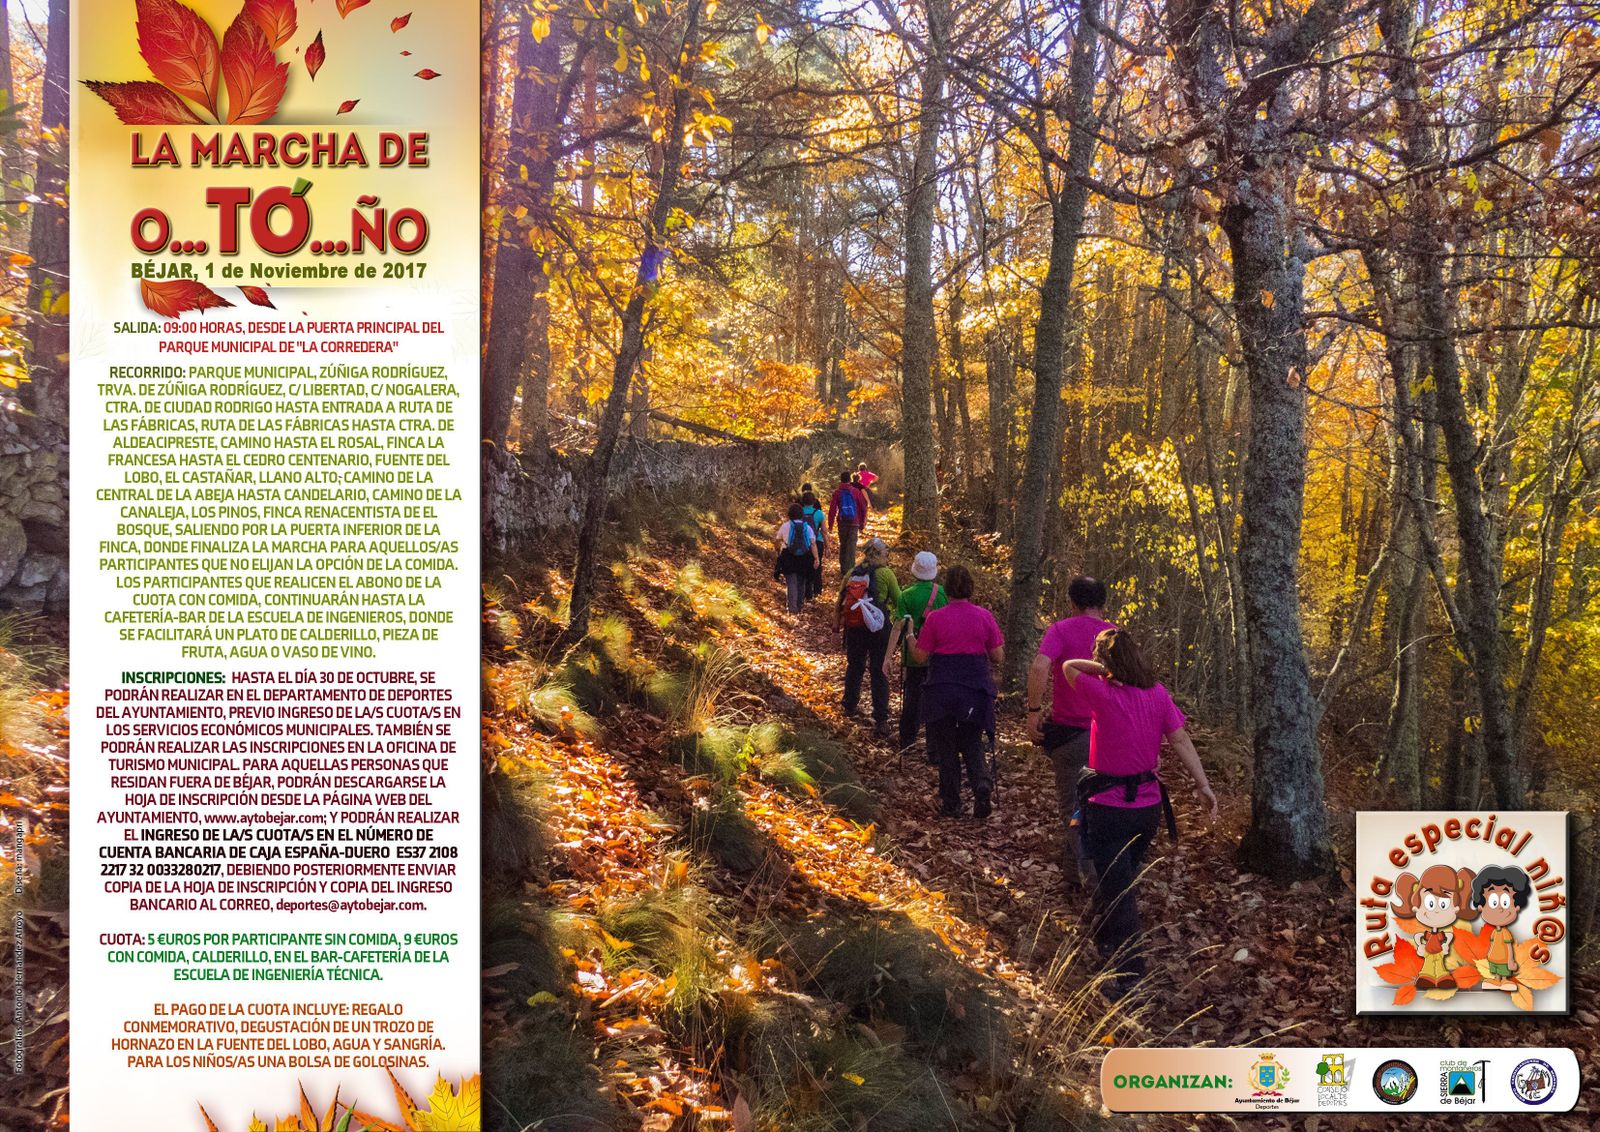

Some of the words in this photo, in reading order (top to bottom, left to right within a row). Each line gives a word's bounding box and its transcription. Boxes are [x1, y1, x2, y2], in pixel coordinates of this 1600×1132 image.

[131, 131, 179, 167] LA
[190, 131, 368, 167] MARCHA
[379, 131, 429, 167] DE
[131, 259, 199, 281] BÉJAR,
[205, 263, 214, 278] 1
[221, 262, 244, 279] de
[250, 262, 348, 279] Noviembre
[354, 262, 377, 279] de
[382, 262, 427, 279] 2017
[114, 322, 161, 334] SALIDA:
[164, 322, 196, 334] 09:00
[200, 322, 245, 336] HORAS,
[248, 322, 286, 334] DESDE
[289, 322, 304, 334] LA
[308, 322, 354, 334] PUERTA
[357, 322, 419, 334] PRINCIPAL
[423, 322, 444, 334] DEL
[160, 341, 208, 355] PARQUE
[212, 341, 276, 353] MUNICIPAL
[280, 341, 294, 353] DE
[297, 341, 318, 353] "LA
[321, 341, 398, 353] CORREDERA"
[110, 366, 185, 379] RECORRIDO:
[189, 366, 241, 381] PARQUE
[245, 366, 316, 381] MUNICIPAL,
[319, 363, 368, 379] ZÚÑIGA
[372, 363, 447, 381] RODRÍGUEZ,
[104, 419, 128, 431] LAS
[131, 416, 198, 434] FÁBRICAS,
[201, 419, 236, 431] RUTA
[239, 419, 254, 431] DE
[258, 419, 282, 431] LAS
[286, 416, 349, 431] FÁBRICAS
[352, 419, 395, 431] HASTA
[399, 419, 435, 431] CTRA.
[438, 419, 454, 431] DE
[109, 454, 176, 466] FRANCESA
[180, 454, 223, 466] HASTA
[226, 454, 241, 466] EL
[244, 454, 285, 466] CEDRO
[289, 454, 372, 469] CENTENARIO,
[376, 454, 423, 466] FUENTE
[427, 454, 450, 466] DEL
[121, 506, 188, 521] CANALEJA,
[192, 506, 216, 518] LOS
[219, 506, 260, 521] PINOS,
[264, 506, 302, 518] FINCA
[305, 506, 400, 518] RENACENTISTA
[404, 506, 420, 518] DE
[424, 506, 437, 518] EL
[100, 558, 198, 571] PARTICIPANTES
[202, 558, 227, 573] QUE
[230, 558, 249, 571] NO
[252, 558, 293, 573] ELIJAN
[297, 558, 312, 571] LA
[316, 555, 363, 571] OPCIÓN
[367, 558, 382, 571] DE
[386, 558, 402, 571] LA
[406, 558, 458, 571] COMIDA.
[133, 593, 176, 606] CUOTA
[179, 593, 205, 606] CON
[209, 593, 261, 608] COMIDA,
[265, 590, 358, 606] CONTINUARÁN
[362, 593, 405, 606] HASTA
[409, 593, 425, 606] LA
[182, 646, 226, 661] FRUTA,
[230, 646, 268, 658] AGUA
[271, 646, 279, 658] O
[282, 646, 318, 658] VASO
[322, 646, 338, 658] DE
[341, 646, 375, 658] VINO.
[122, 672, 225, 684] INSCRIPCIONES:
[232, 672, 275, 684] HASTA
[279, 672, 292, 684] EL
[295, 669, 317, 684] DÍA
[320, 672, 334, 684] 30
[338, 672, 353, 684] DE
[357, 672, 417, 686] OCTUBRE,
[420, 672, 435, 684] SE
[105, 686, 158, 702] PODRÁN
[162, 689, 223, 702] REALIZAR
[227, 689, 243, 702] EN
[247, 689, 261, 702] EL
[264, 689, 366, 702] DEPARTAMENTO
[369, 689, 385, 702] DE
[388, 689, 452, 702] DEPORTES
[107, 724, 130, 736] LOS
[133, 724, 198, 736] SERVICIOS
[201, 721, 283, 736] ECONÓMICOS
[287, 724, 373, 736] MUNICIPALES.
[376, 721, 432, 736] TAMBIÉN
[436, 724, 451, 736] SE
[97, 811, 201, 826] AYUNTAMIENTO,
[204, 811, 326, 826] www.aytobejar.com;
[330, 811, 338, 823] Y
[341, 808, 394, 823] PODRÁN
[398, 811, 459, 823] REALIZAR
[100, 846, 152, 858] CUENTA
[156, 846, 226, 858] BANCARIA
[230, 846, 246, 858] DE
[250, 846, 281, 861] CAJA
[285, 843, 390, 858] ESPAÑA-DUERO
[397, 846, 426, 858] ES37
[429, 846, 458, 858] 2108
[101, 863, 127, 876] 2217
[130, 863, 143, 876] 32
[147, 863, 224, 878] 0033280217,
[227, 863, 290, 876] DEBIENDO
[294, 863, 405, 876] POSTERIORMENTE
[408, 863, 456, 876] ENVIAR
[1360, 875, 1394, 960] Ruta
[1388, 814, 1533, 868] especial
[1525, 856, 1566, 964] niñ@s
[131, 898, 197, 911] BANCARIO
[200, 898, 217, 911] AL
[220, 898, 273, 913] CORREO,
[277, 898, 426, 913] deportes@aytobejar.com.
[14, 911, 24, 940] Arroyo
[174, 968, 230, 981] ESCUELA
[233, 968, 249, 981] DE
[252, 965, 324, 981] INGENIERÍA
[327, 965, 383, 981] TÉCNICA.
[14, 989, 23, 1023] Antonio
[124, 1021, 238, 1035] CONMEMORATIVO,
[241, 1018, 330, 1033] DEGUSTACIÓN
[334, 1021, 349, 1033] DE
[352, 1021, 370, 1033] UN
[373, 1021, 414, 1033] TROZO
[418, 1021, 433, 1033] DE
[1113, 1074, 1233, 1089] ORGANIZAN:
[1440, 1072, 1448, 1097] SIERRA
[1440, 1097, 1452, 1105] de
[1454, 1097, 1476, 1106] Béjar
